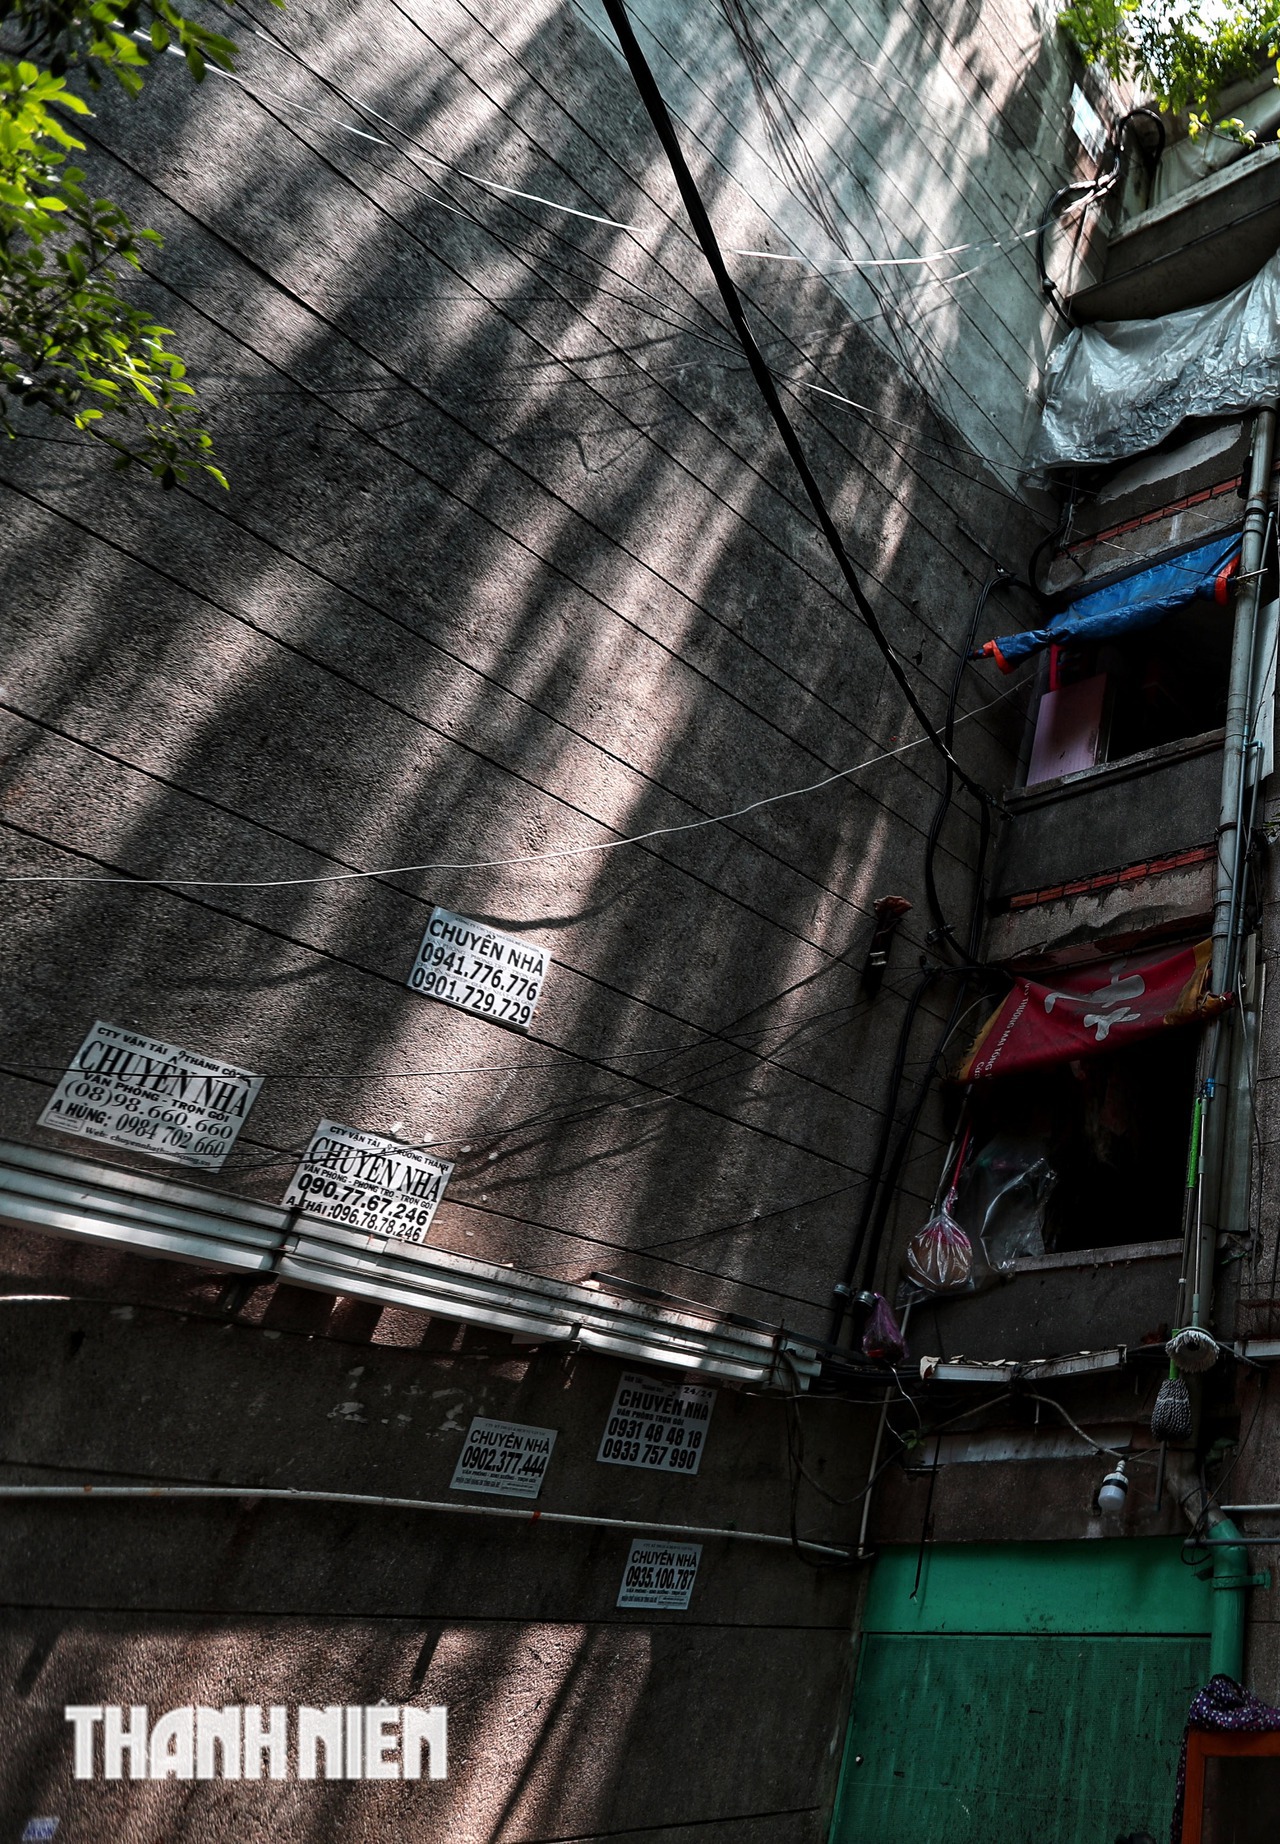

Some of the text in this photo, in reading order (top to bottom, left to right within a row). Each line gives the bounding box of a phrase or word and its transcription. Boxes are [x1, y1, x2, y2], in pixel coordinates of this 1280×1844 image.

[429, 919, 504, 960] CHUYỂN
[507, 949, 543, 976] NHÀ
[420, 942, 538, 1001] 0941.776.776
[411, 967, 530, 1024] 0901.729.729
[97, 1027, 252, 1083] CTY VẬN TẢI THÀNH CÔ
[79, 1041, 252, 1118] CHUYỂN NHÀ
[83, 1070, 229, 1122] VĂN PHÒNG TRỌN GÓI
[50, 1099, 63, 1112] A
[64, 1102, 111, 1126] HÙNG:
[115, 1113, 159, 1139] 0984
[161, 1125, 193, 1149] 702
[193, 1136, 225, 1158] 660
[64, 1079, 233, 1139] (08)98.660.660
[85, 1126, 108, 1138] Web:
[329, 1126, 347, 1135] CTY
[348, 1131, 365, 1142] VẬN
[367, 1137, 380, 1147] TẢI
[307, 1137, 445, 1202] CHUYỂN NHÀ
[298, 1174, 428, 1226] 090.77.67.246
[618, 1389, 683, 1416] CHUYỂN
[683, 1386, 713, 1398] 24/24
[470, 1429, 523, 1449] CHUYỂN
[523, 1437, 549, 1454] NHÀ
[602, 1437, 696, 1469] 0933 757 990
[607, 1417, 702, 1448] 0931 48 48 18
[461, 1445, 547, 1477] 0902.377.444
[625, 1565, 695, 1590] 0935.100.787
[631, 1549, 696, 1567] CHUYỂN NHÀ
